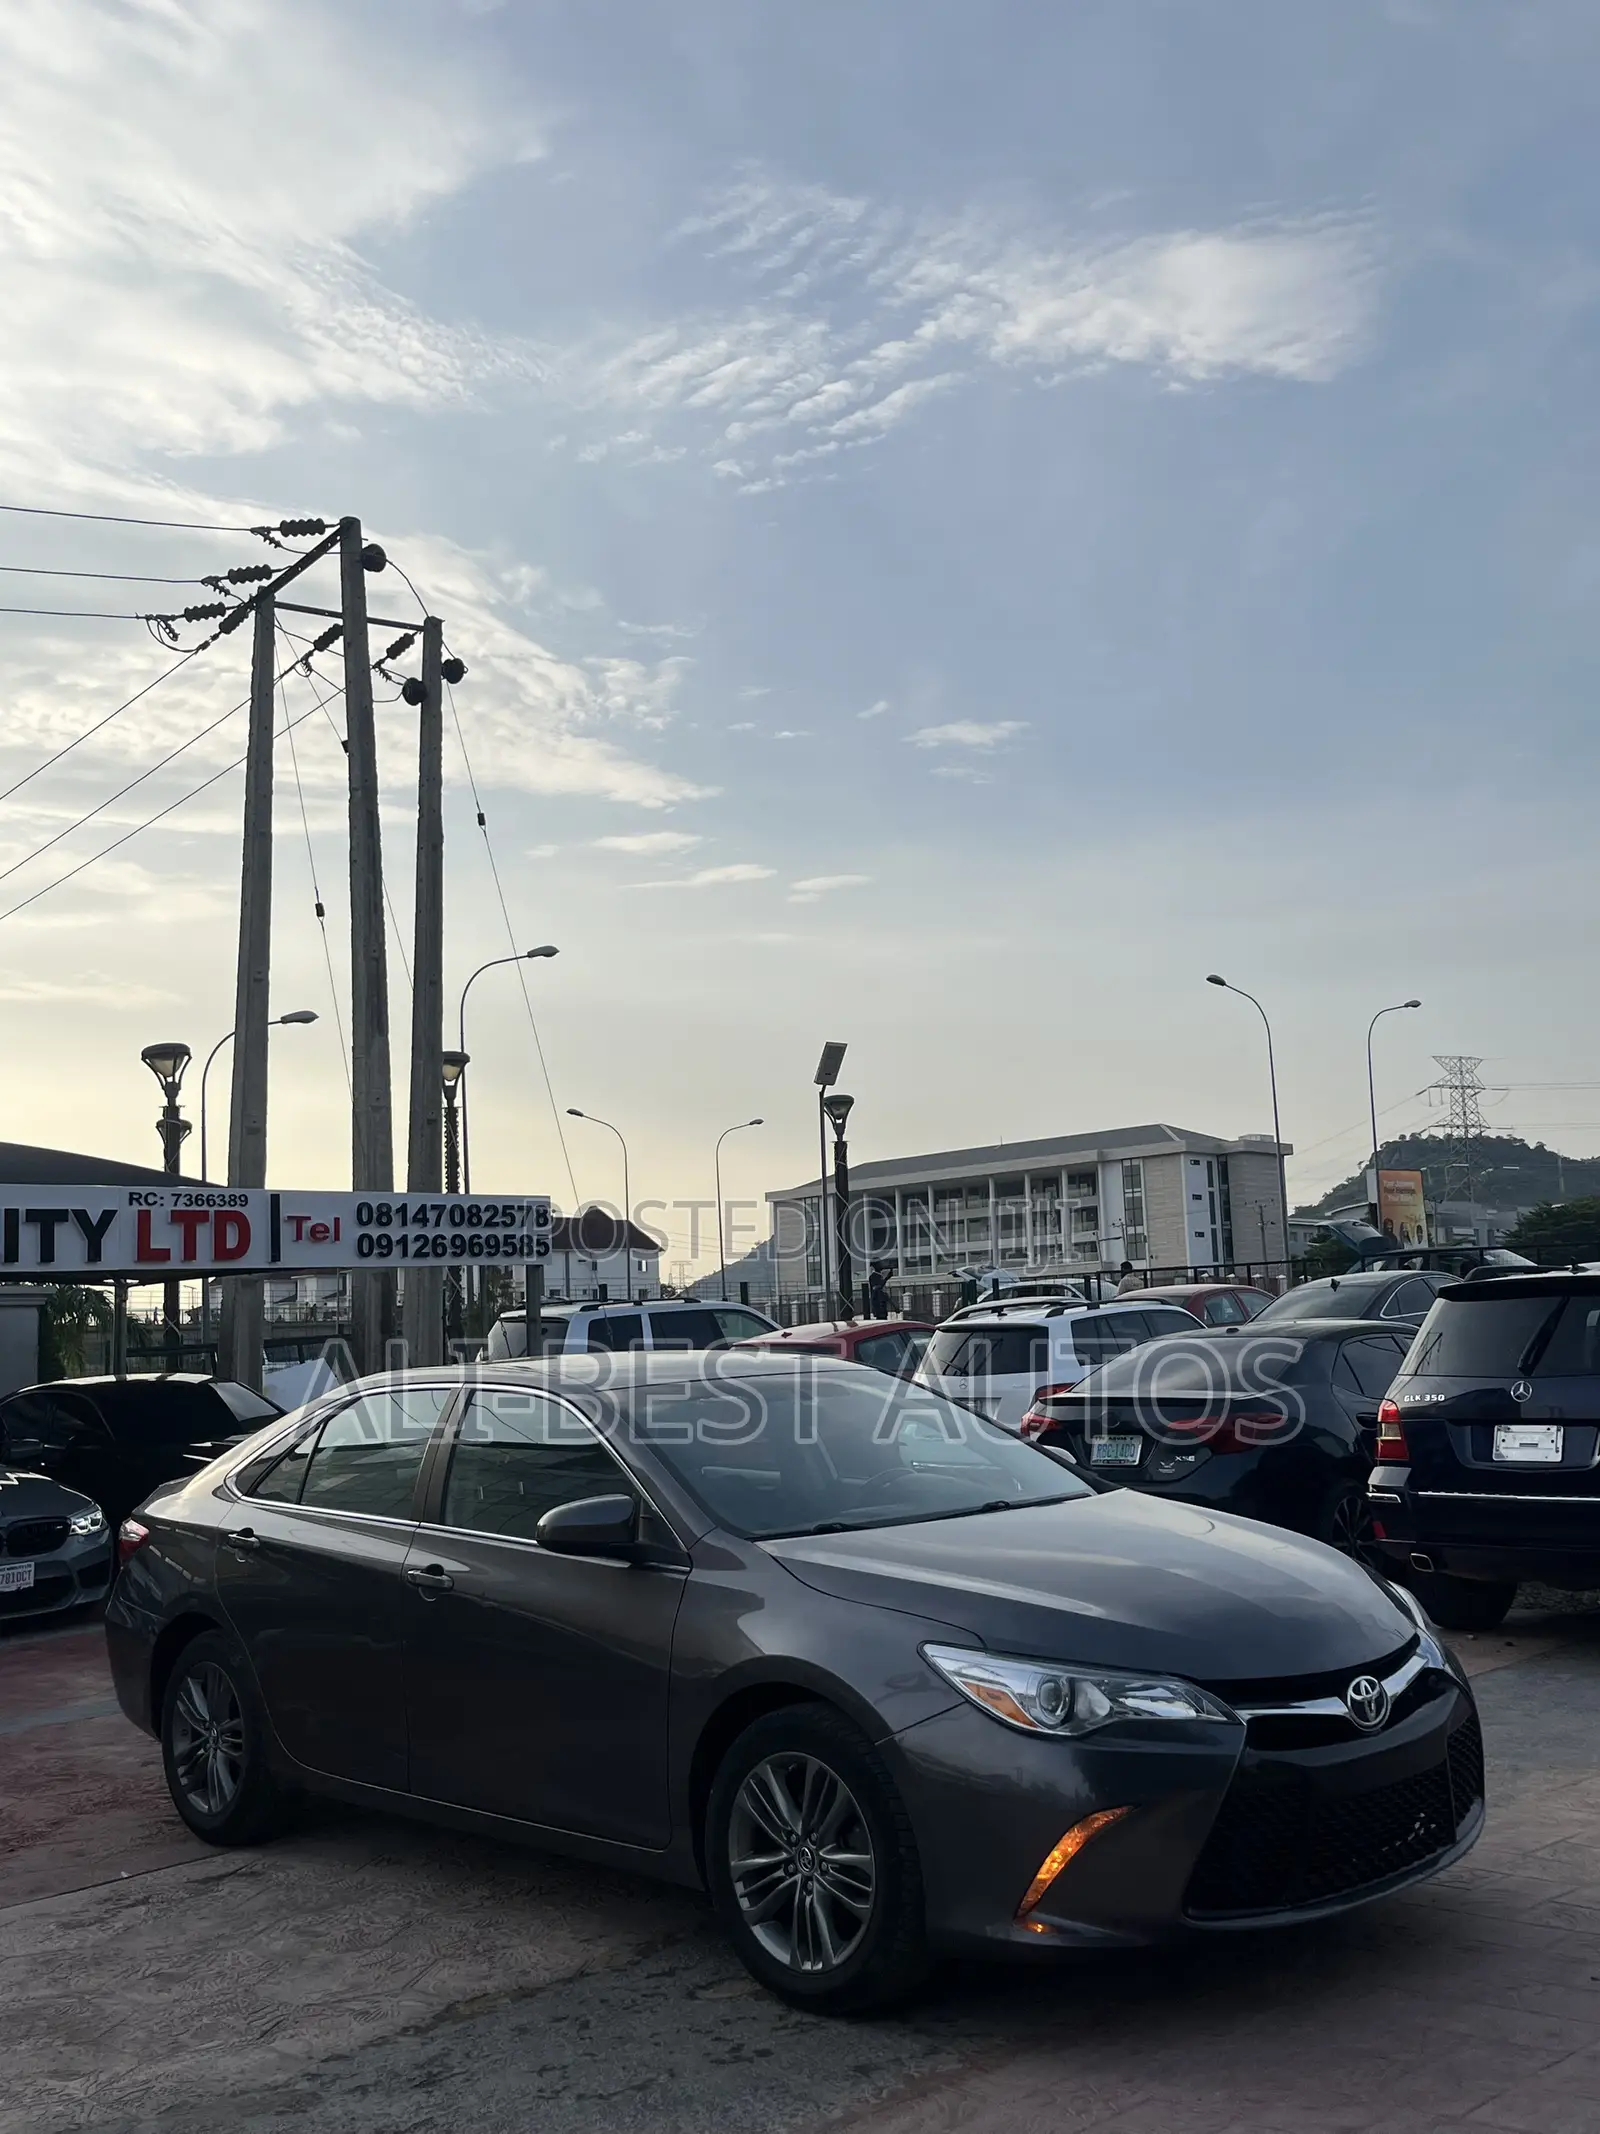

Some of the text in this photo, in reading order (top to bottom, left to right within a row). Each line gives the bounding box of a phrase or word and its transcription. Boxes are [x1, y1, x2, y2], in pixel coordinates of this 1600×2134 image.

[128, 1192, 249, 1207] RC: 7366389
[356, 1202, 550, 1227] 08147082578
[3, 1208, 251, 1263] ITY LTD
[285, 1215, 341, 1243] Tel
[357, 1233, 550, 1258] 09126969585
[1403, 1394, 1445, 1402] GLK 350
